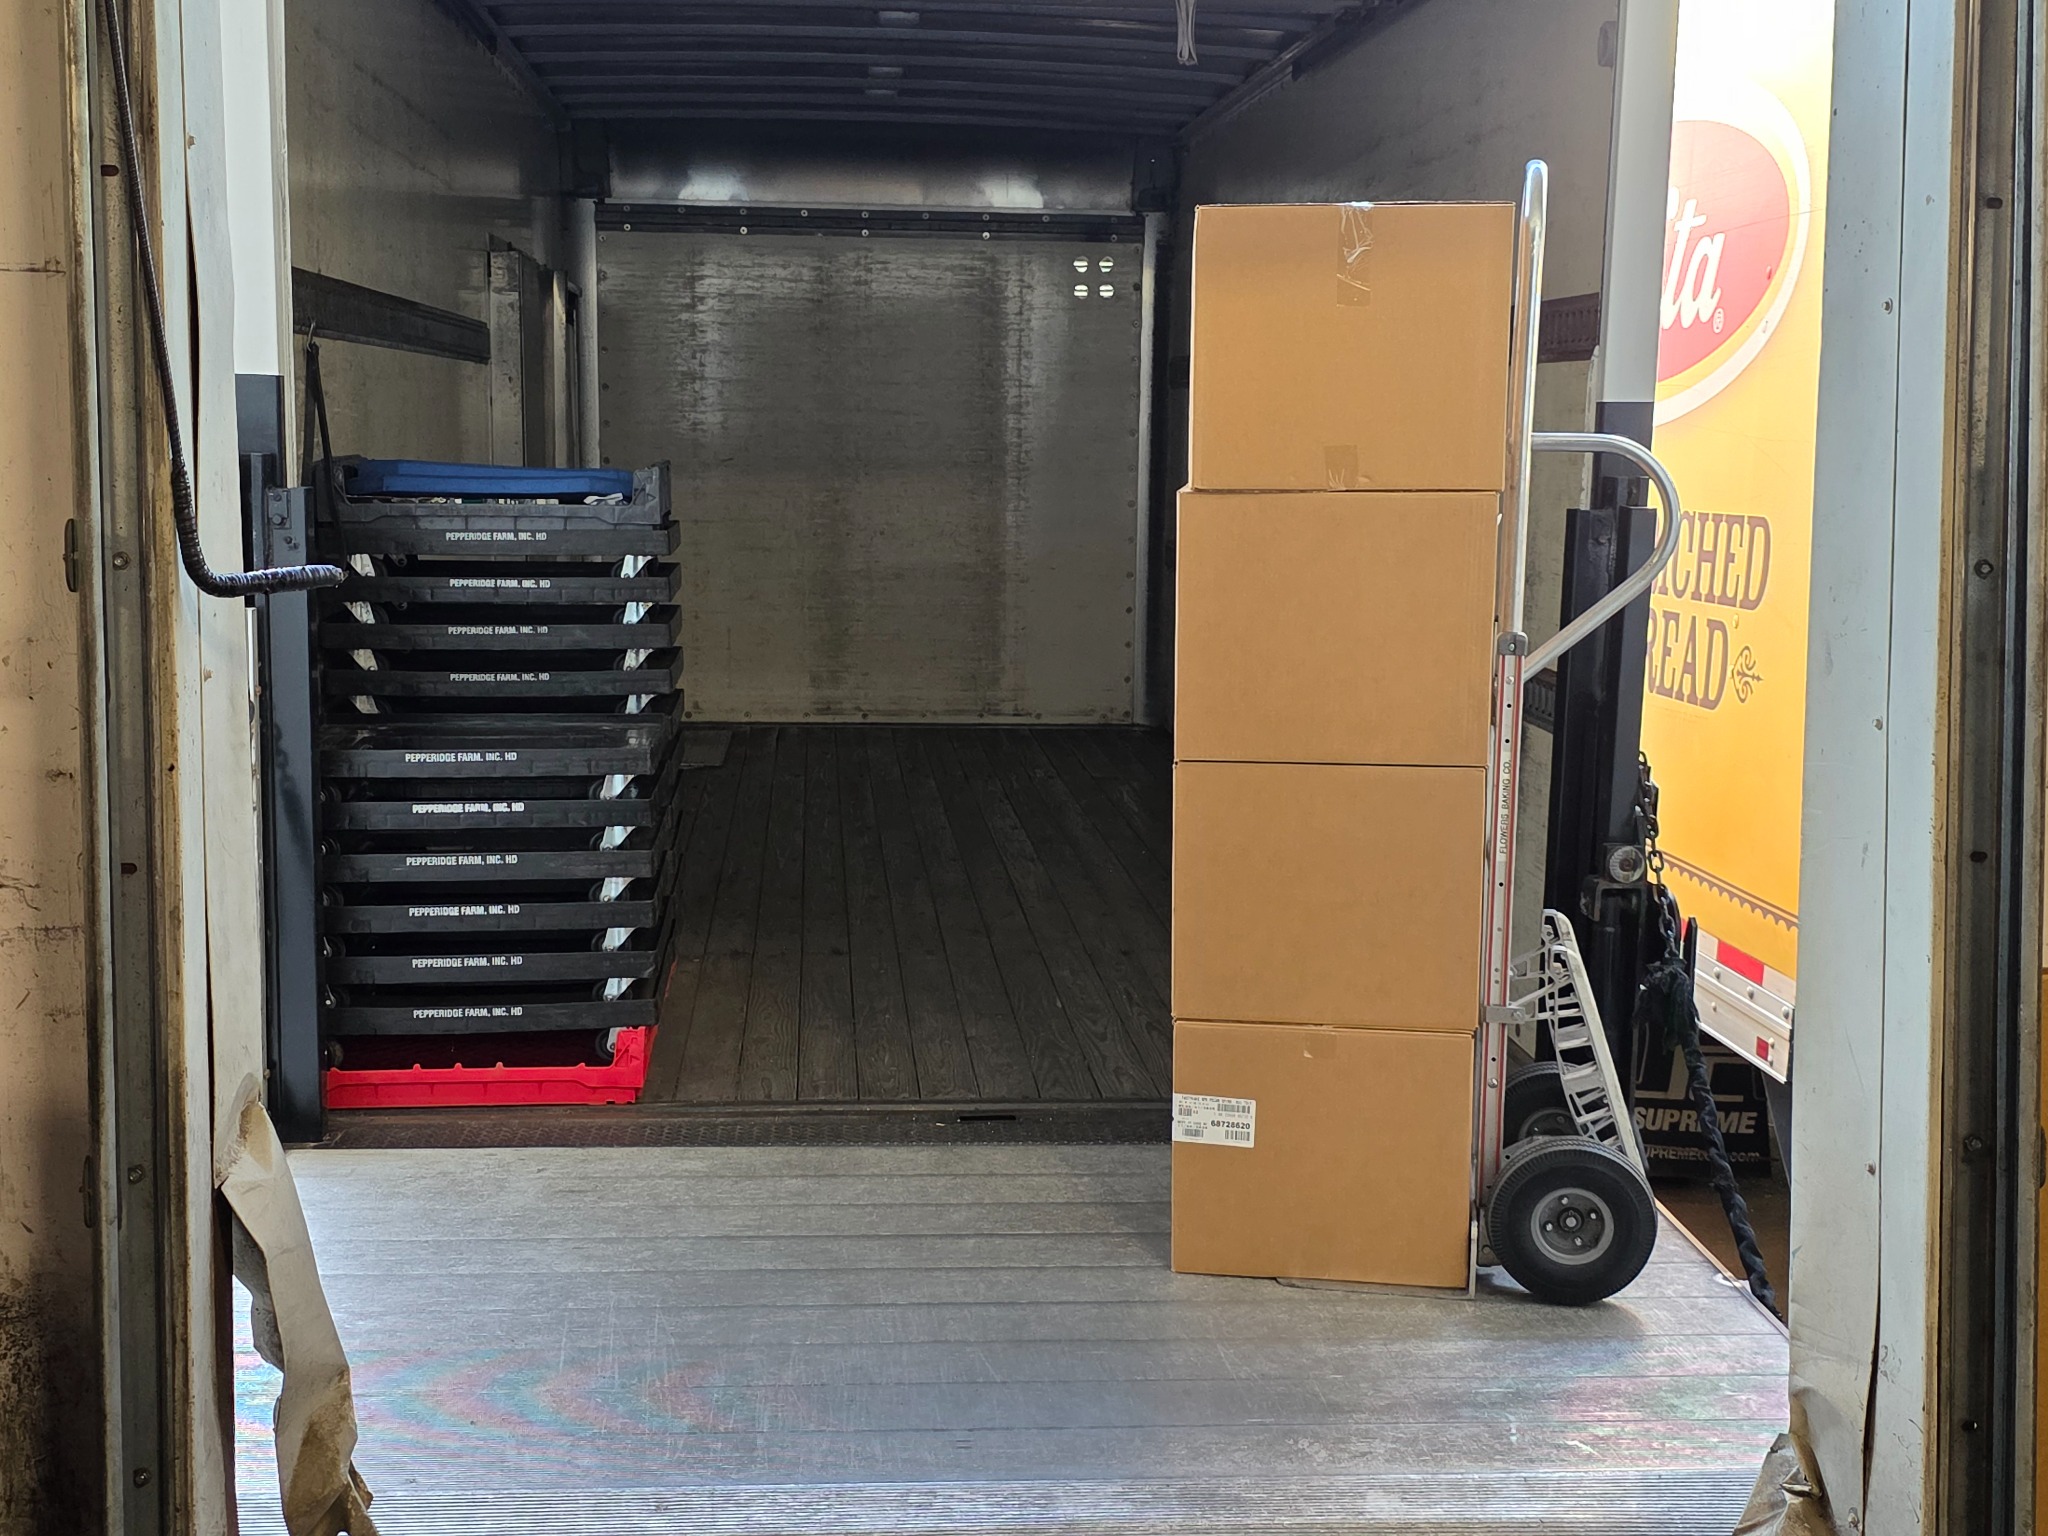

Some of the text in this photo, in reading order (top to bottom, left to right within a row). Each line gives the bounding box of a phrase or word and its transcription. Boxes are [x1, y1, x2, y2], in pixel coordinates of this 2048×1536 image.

[1660, 186, 1726, 330] ta
[445, 531, 492, 541] PEPPERIDGE
[517, 531, 535, 541] INC.
[535, 532, 547, 541] HD
[449, 578, 496, 588] PEPPERIDGE
[521, 579, 538, 588] INC.
[539, 579, 551, 589] HD
[447, 626, 494, 635] PEPPERIDGE
[519, 625, 535, 634] INC.
[536, 625, 549, 634] HD
[449, 673, 496, 682] PEPPERIDGE
[521, 672, 538, 682] INC.
[538, 672, 550, 681] HD
[405, 752, 457, 763] PEPPERIDGE
[485, 752, 503, 761] INC.
[504, 751, 518, 761] HD
[412, 803, 464, 814] PEPPERIDGE
[492, 802, 511, 813] INC.
[511, 802, 525, 812] HD
[1499, 759, 1511, 855] FLOWERS BAKING CO.
[406, 856, 458, 866] PEPPERIDGE
[486, 854, 505, 865] INC.
[505, 854, 518, 864] HD
[408, 906, 460, 917] PEPPERIDGE
[488, 904, 506, 915] INC.
[507, 904, 520, 914] HD
[411, 957, 463, 969] PEPPERIDGE
[491, 956, 509, 966] INC.
[510, 956, 523, 966] HD
[413, 1008, 464, 1019] PEPPERIDGE
[492, 1007, 509, 1017] INC.
[510, 1006, 523, 1016] HD
[1211, 1120, 1251, 1130] 68728620
[1633, 1107, 1758, 1134] SUPRME
